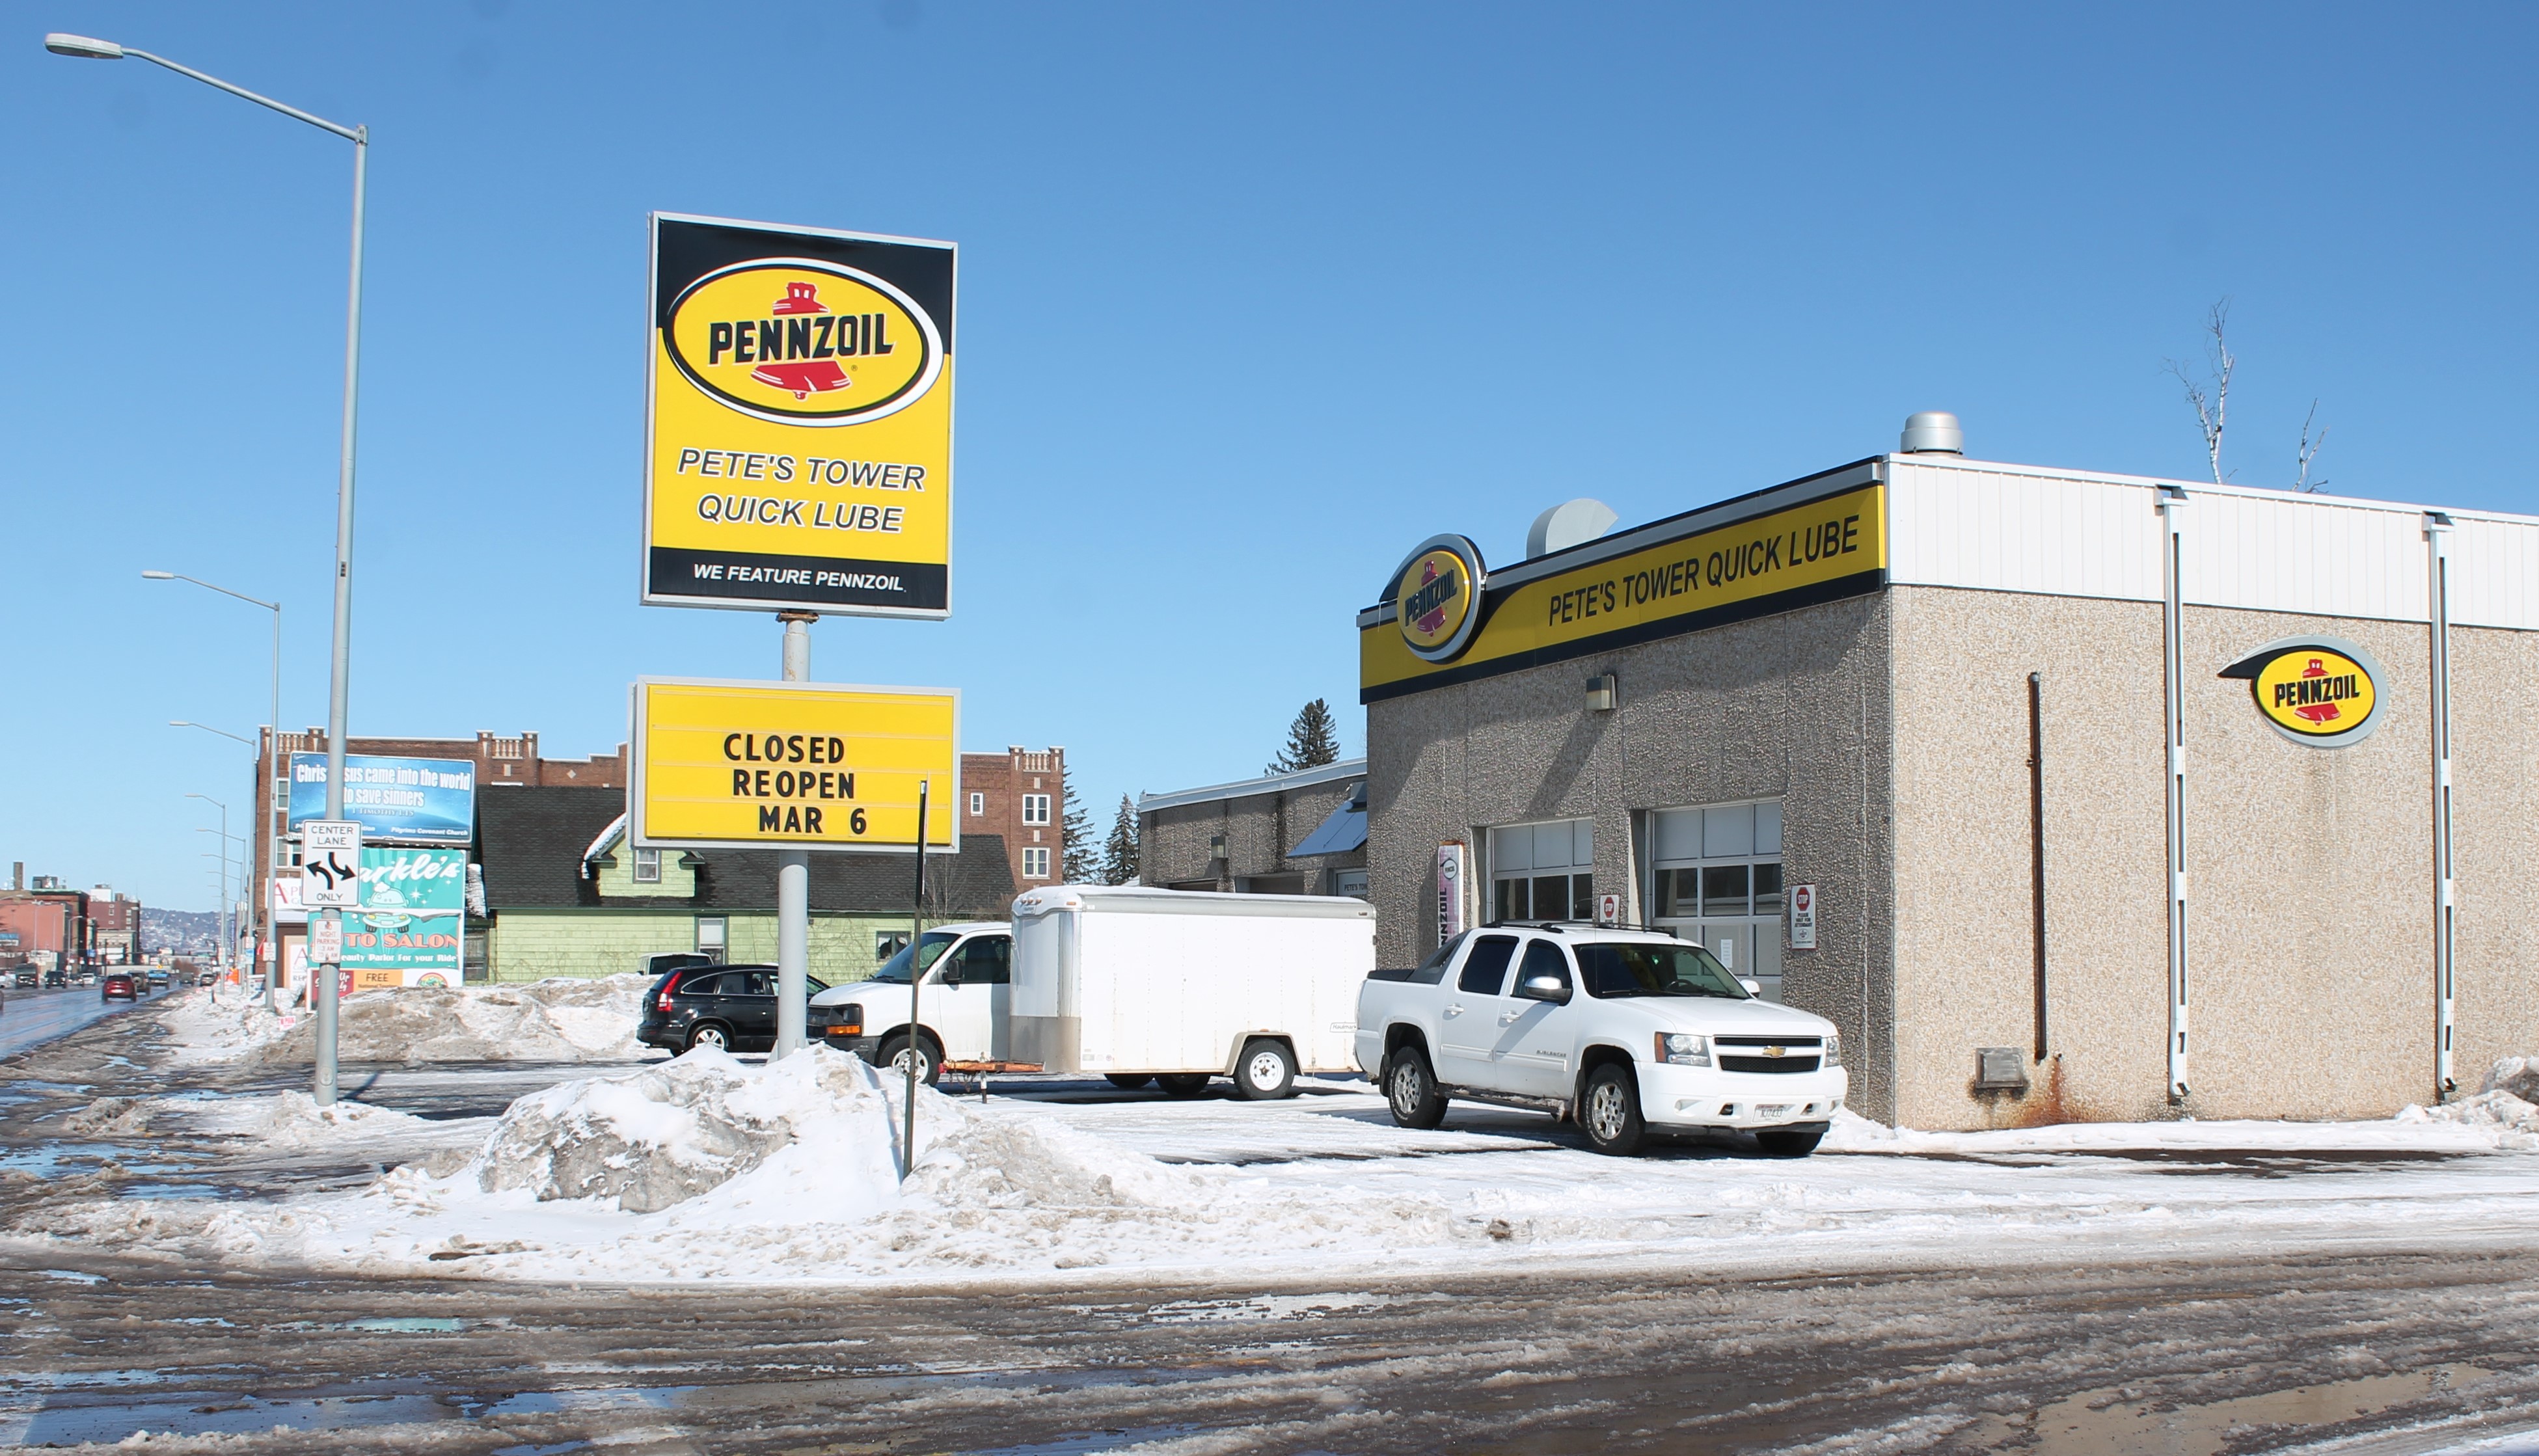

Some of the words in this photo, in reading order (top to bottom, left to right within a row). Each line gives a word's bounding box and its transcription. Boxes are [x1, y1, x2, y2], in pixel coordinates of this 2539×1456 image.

[710, 314, 895, 366] PENNZOIL
[677, 448, 796, 482] PETE'S
[806, 458, 927, 492] TOWER
[698, 494, 806, 527] QUICK
[813, 503, 905, 534] LUBE
[694, 564, 724, 581] WE
[727, 566, 812, 586] FEATURE
[815, 571, 904, 592] PENNZOIL
[1549, 583, 1616, 627] PETE'S
[1622, 558, 1699, 605] TOWER
[1706, 535, 1782, 587] QUICK
[1788, 515, 1860, 565] LUBE
[1405, 568, 1458, 627] PENNZOIL
[2274, 674, 2361, 708] PENNZOIL
[724, 733, 845, 764] CLOSED
[297, 764, 327, 783] Chris
[344, 767, 363, 783] sus
[365, 768, 396, 784] came
[397, 766, 418, 786] into
[420, 768, 439, 787] the
[439, 772, 471, 791] world
[733, 769, 854, 799] REOPEN
[344, 787, 354, 803] to
[356, 788, 381, 805] save
[383, 787, 424, 807] sinners
[311, 826, 353, 835] CENTER
[759, 805, 822, 834] MAR
[850, 808, 866, 835] 6
[317, 837, 347, 846] LANE
[360, 854, 461, 883] arkle's
[316, 893, 343, 902] ONLY
[1798, 895, 1808, 904] STOP
[1439, 887, 1448, 945] NNZOIL
[343, 933, 377, 948] TO
[383, 933, 458, 949] SALON
[341, 954, 365, 963] eauty
[366, 973, 388, 982] FREE
